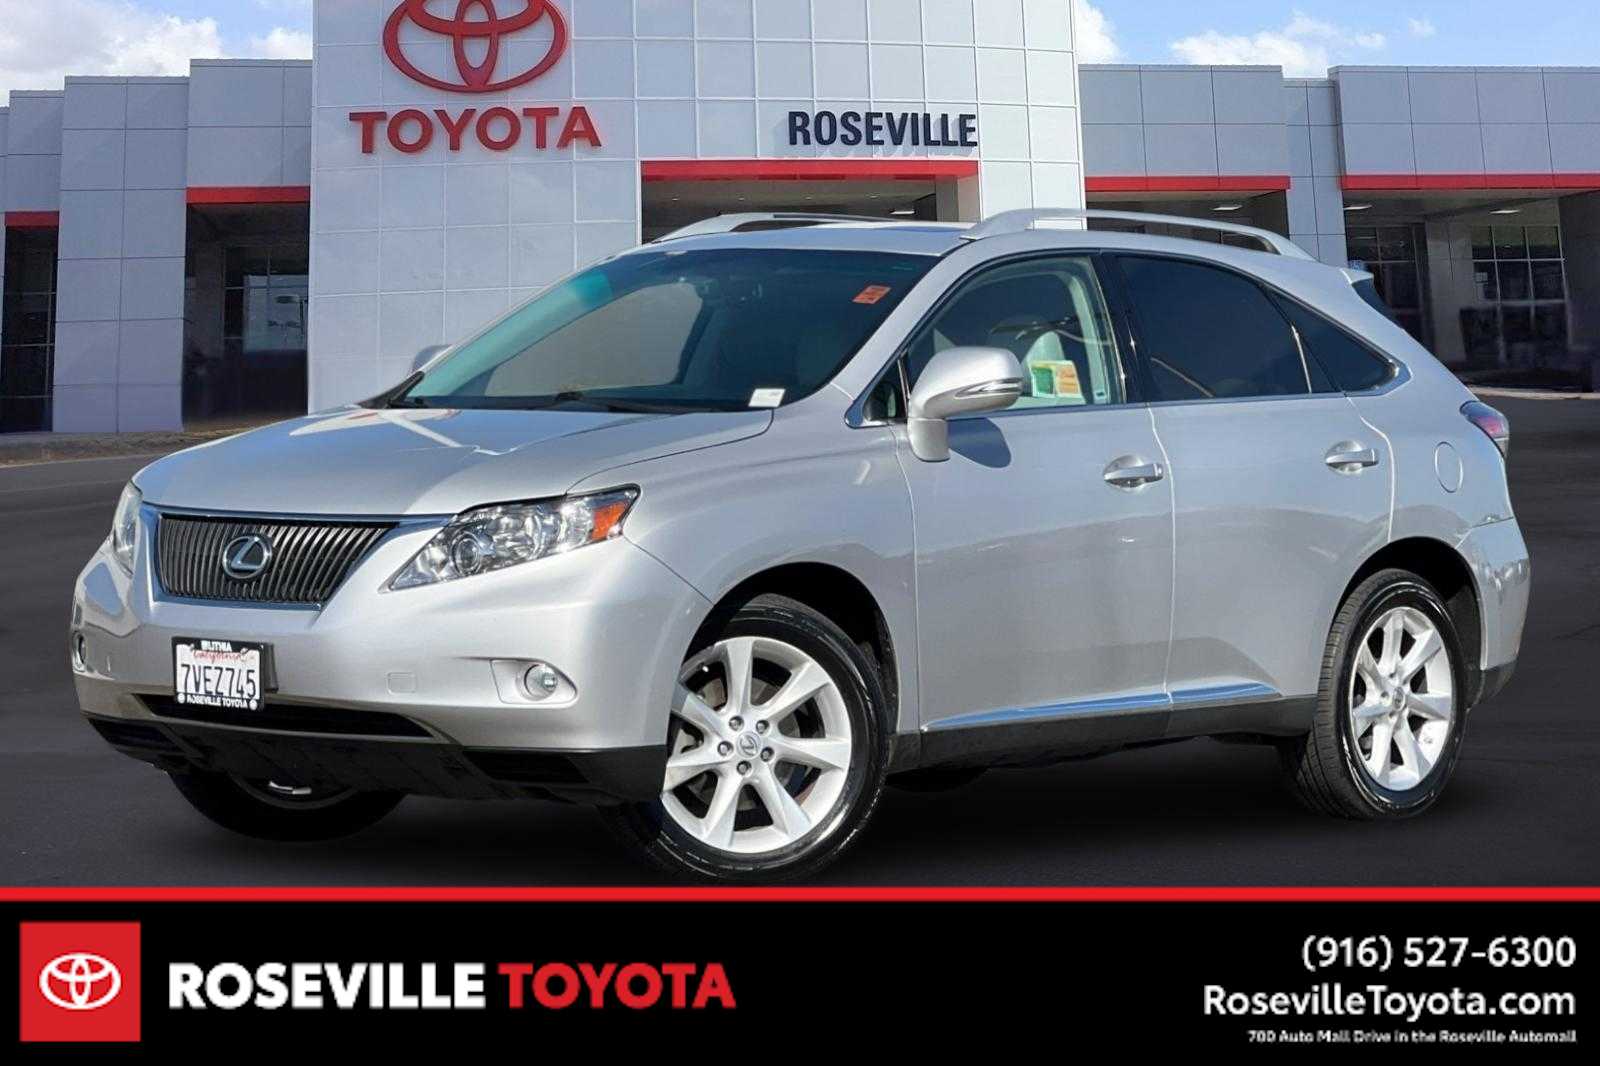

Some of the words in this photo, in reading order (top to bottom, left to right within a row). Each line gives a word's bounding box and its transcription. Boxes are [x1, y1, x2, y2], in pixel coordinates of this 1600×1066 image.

[350, 106, 602, 153] TOYOTA
[788, 110, 978, 147] ROSEVILLE
[181, 663, 257, 698] 7VEZ745
[222, 698, 248, 709] TOYOTA
